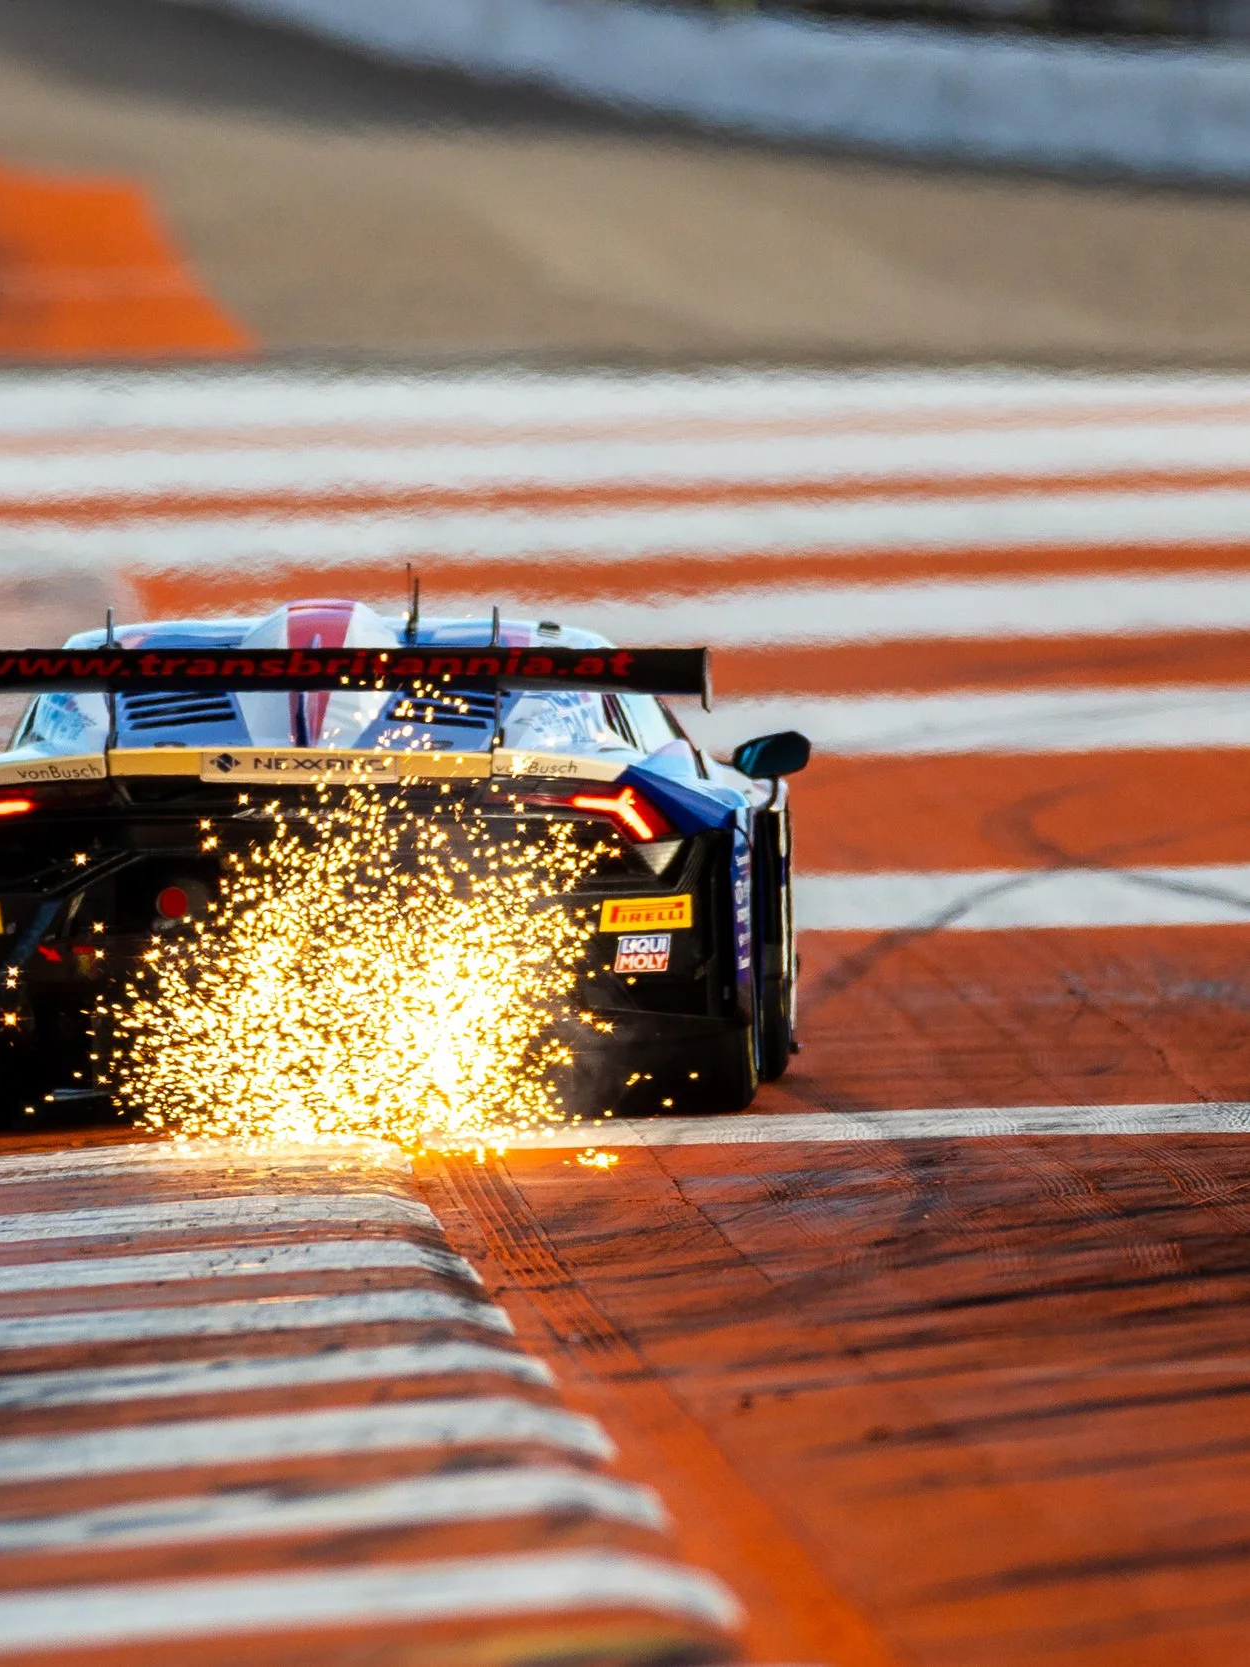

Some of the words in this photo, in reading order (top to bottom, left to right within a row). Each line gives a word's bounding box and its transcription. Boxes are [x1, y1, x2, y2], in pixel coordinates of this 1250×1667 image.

[16, 765, 100, 780] vonBusch
[496, 760, 578, 774] voBusch
[610, 901, 684, 923] PIRELLI
[621, 938, 667, 954] LQUI
[619, 954, 667, 970] MOLY
